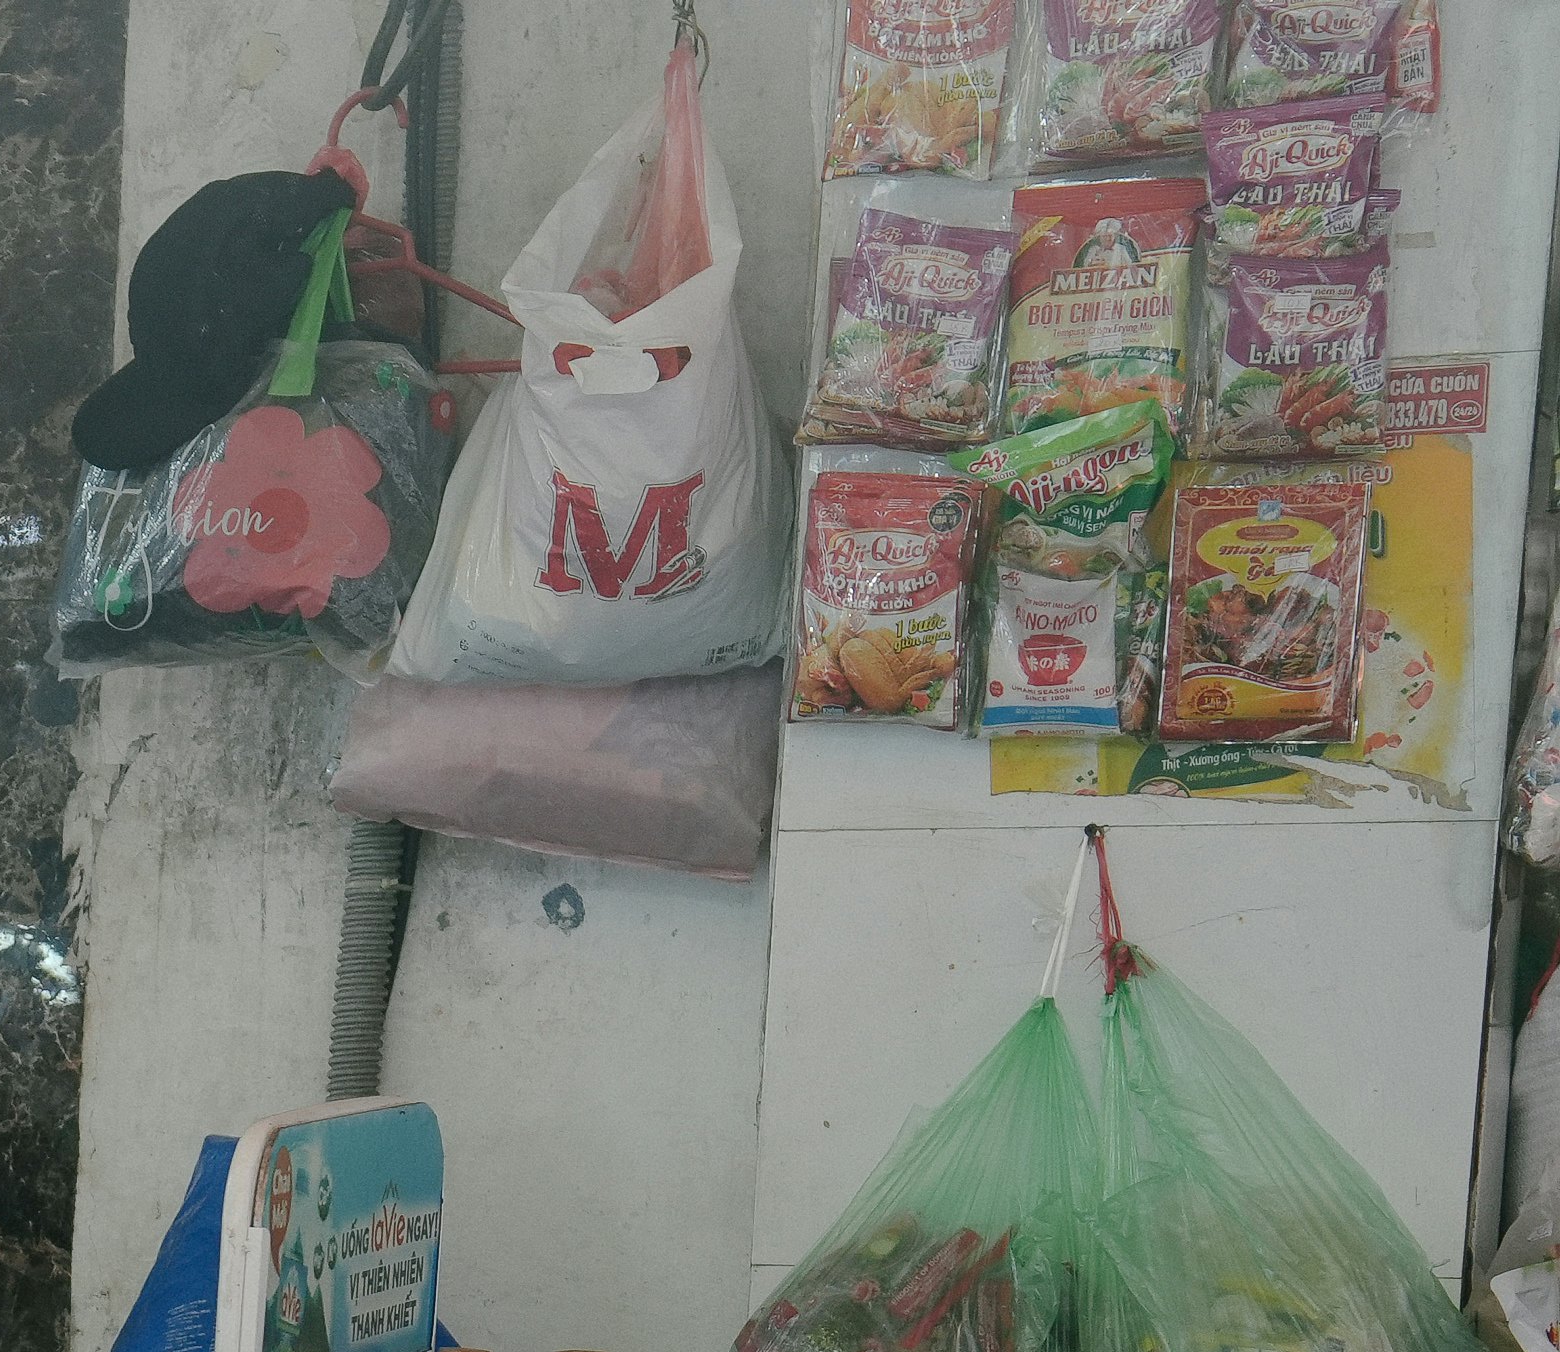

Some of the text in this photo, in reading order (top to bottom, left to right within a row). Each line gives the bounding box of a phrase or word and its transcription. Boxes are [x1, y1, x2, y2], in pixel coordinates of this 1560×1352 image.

[1246, 134, 1350, 180] Aji-Quick
[1294, 177, 1353, 203] THÁI
[880, 261, 979, 295] Aji-Quick
[1054, 266, 1157, 292] MEIZAN
[1028, 300, 1064, 329] BỘT
[1248, 338, 1301, 365] LẨU
[1430, 368, 1480, 394] CUỐN
[830, 531, 940, 569] Aji-Quick
[1036, 686, 1085, 695] SEASONING
[1161, 757, 1181, 772] Thịt
[1189, 753, 1220, 766] Xương
[341, 1202, 439, 1260] UỐNG laVie NGAY!
[349, 1252, 424, 1306] VỊ THIÊN NHIÊN
[351, 1289, 417, 1342] THANH KHIẾT
